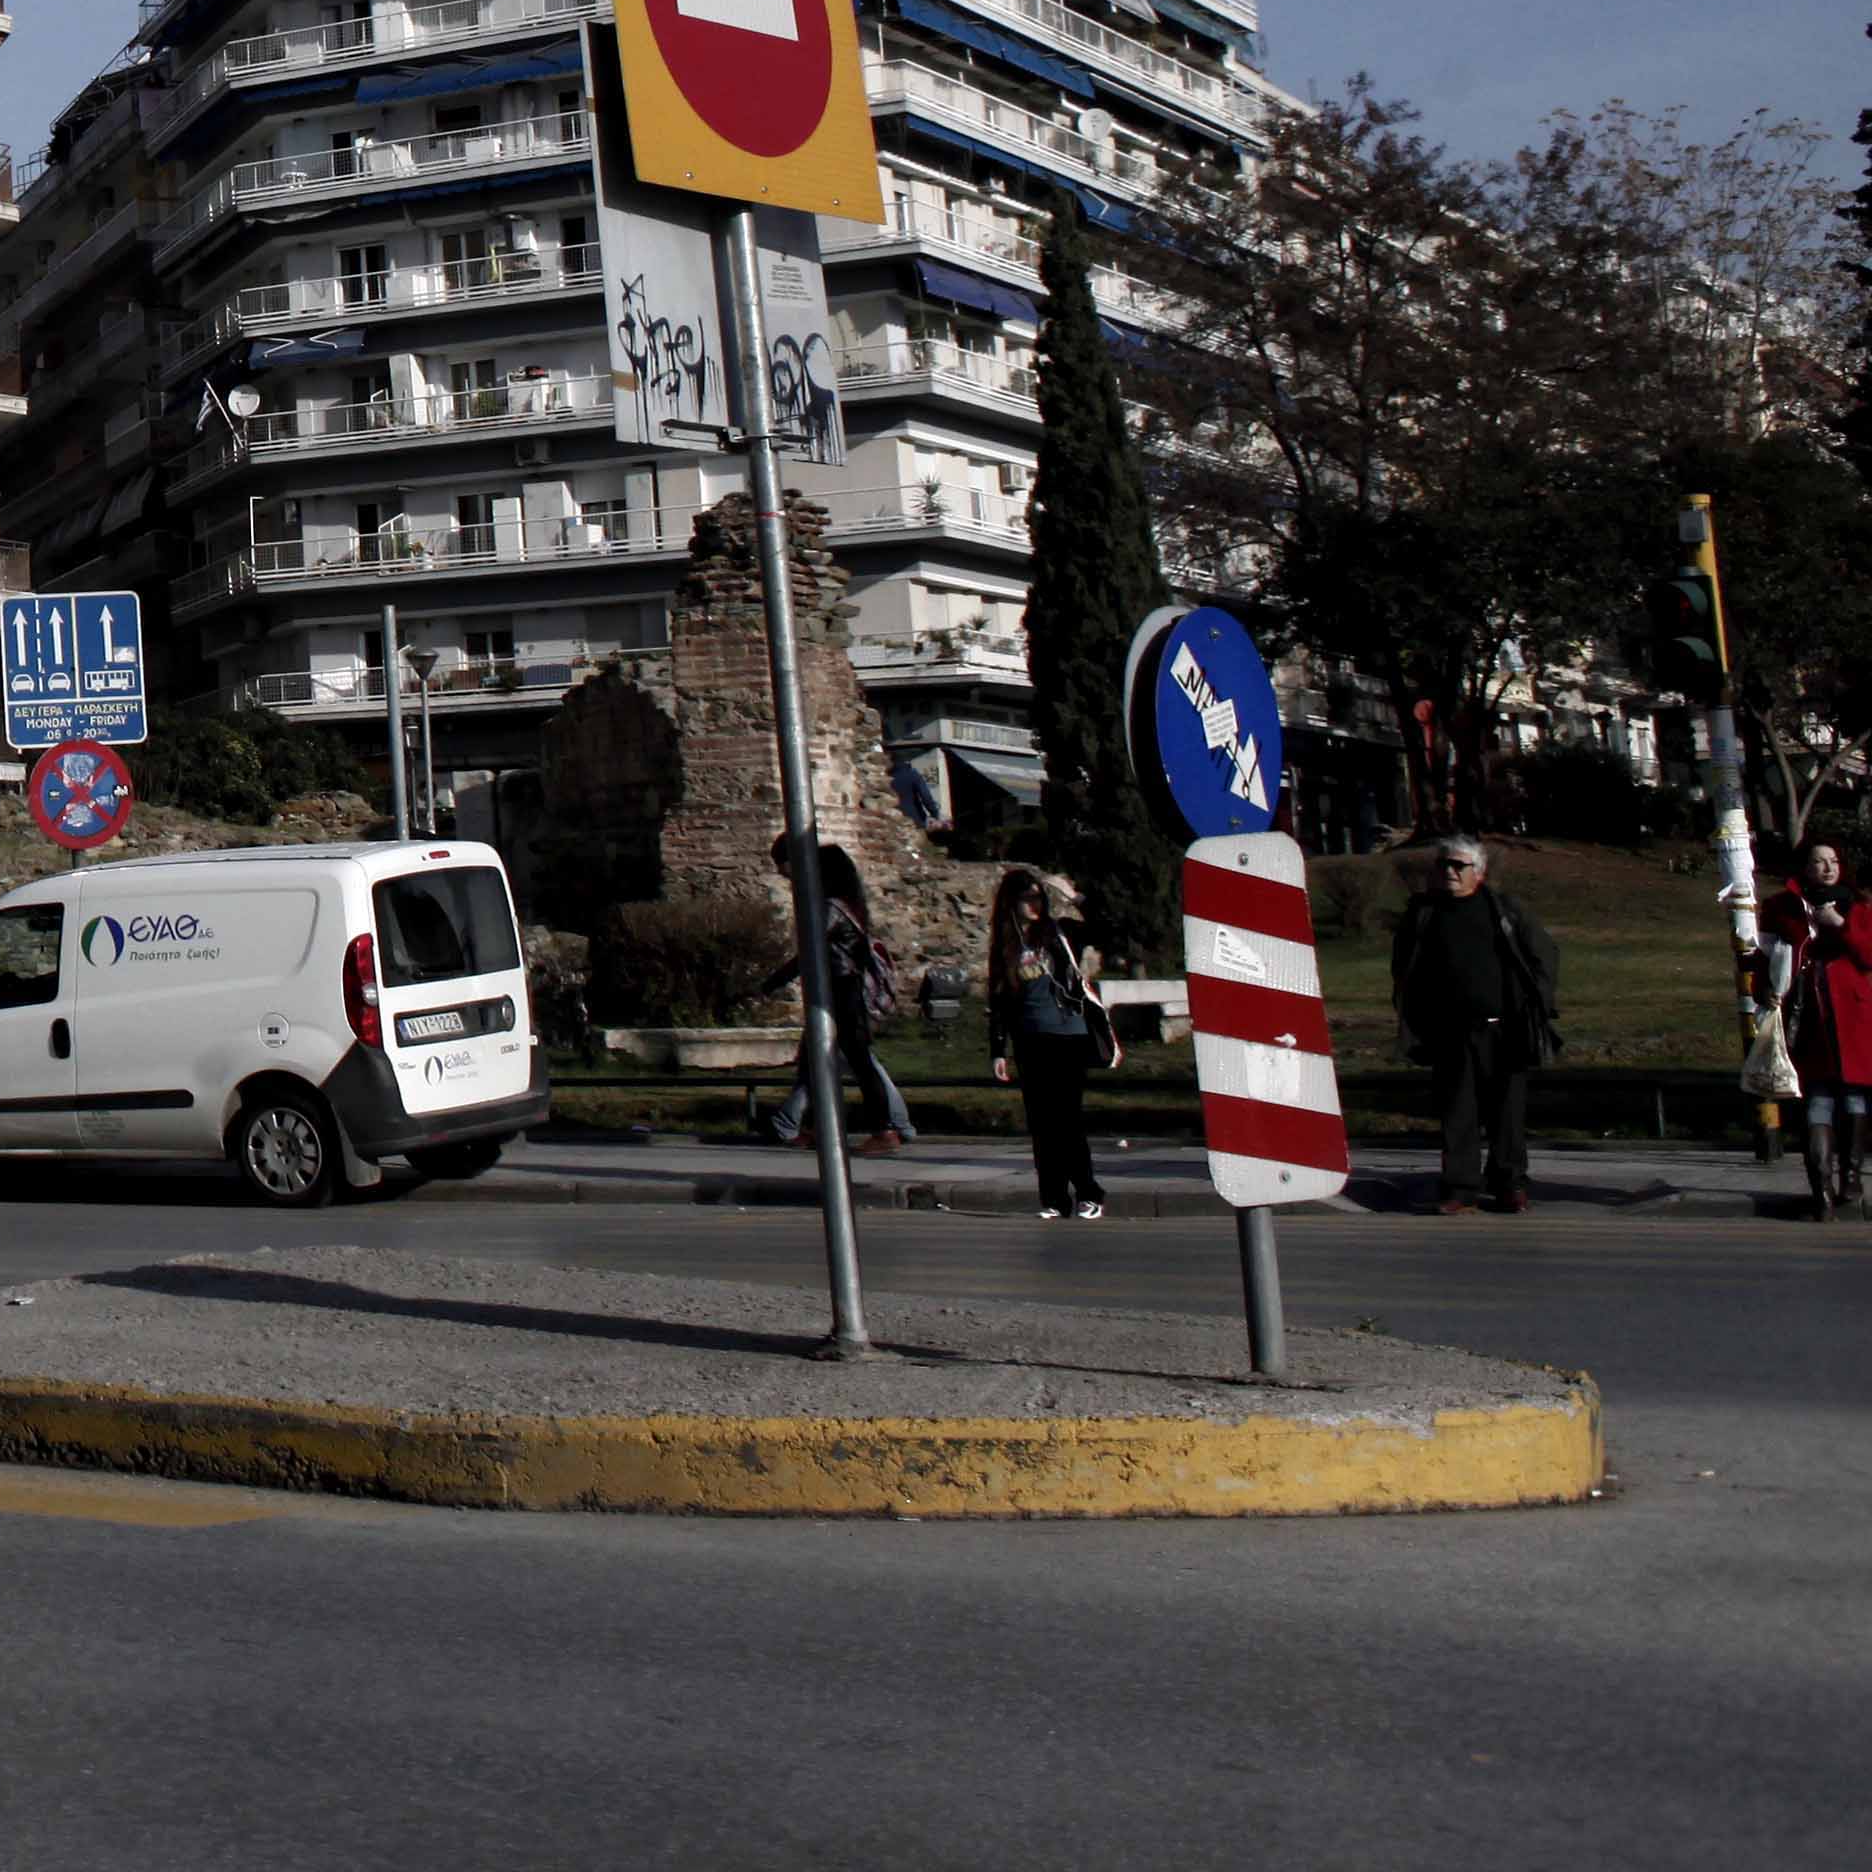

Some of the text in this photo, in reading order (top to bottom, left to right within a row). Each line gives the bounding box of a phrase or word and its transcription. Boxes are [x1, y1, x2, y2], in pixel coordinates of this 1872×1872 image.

[26, 717, 73, 729] MONDAY
[90, 715, 127, 726] FRIDAY
[127, 914, 200, 943] ΕΥΑΘ
